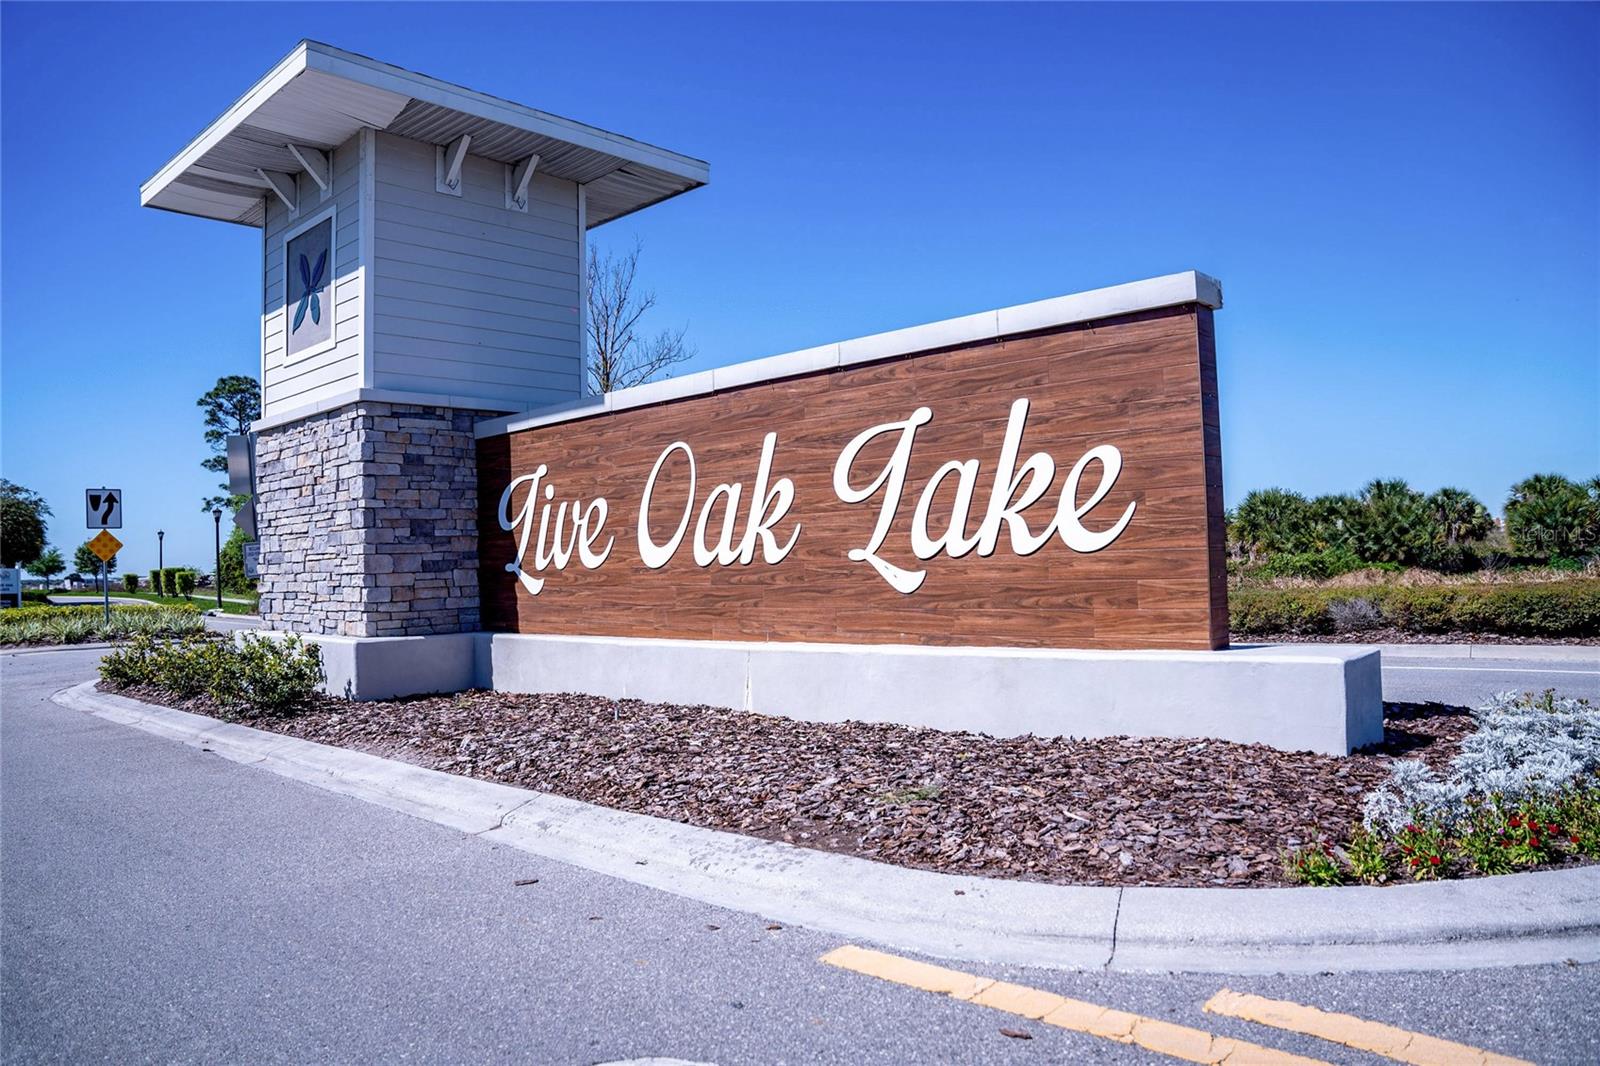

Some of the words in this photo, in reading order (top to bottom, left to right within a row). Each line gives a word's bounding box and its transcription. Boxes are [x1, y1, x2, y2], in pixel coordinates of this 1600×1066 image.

[498, 463, 615, 595] Live
[637, 432, 801, 569] Oak
[833, 398, 1136, 594] Lake
